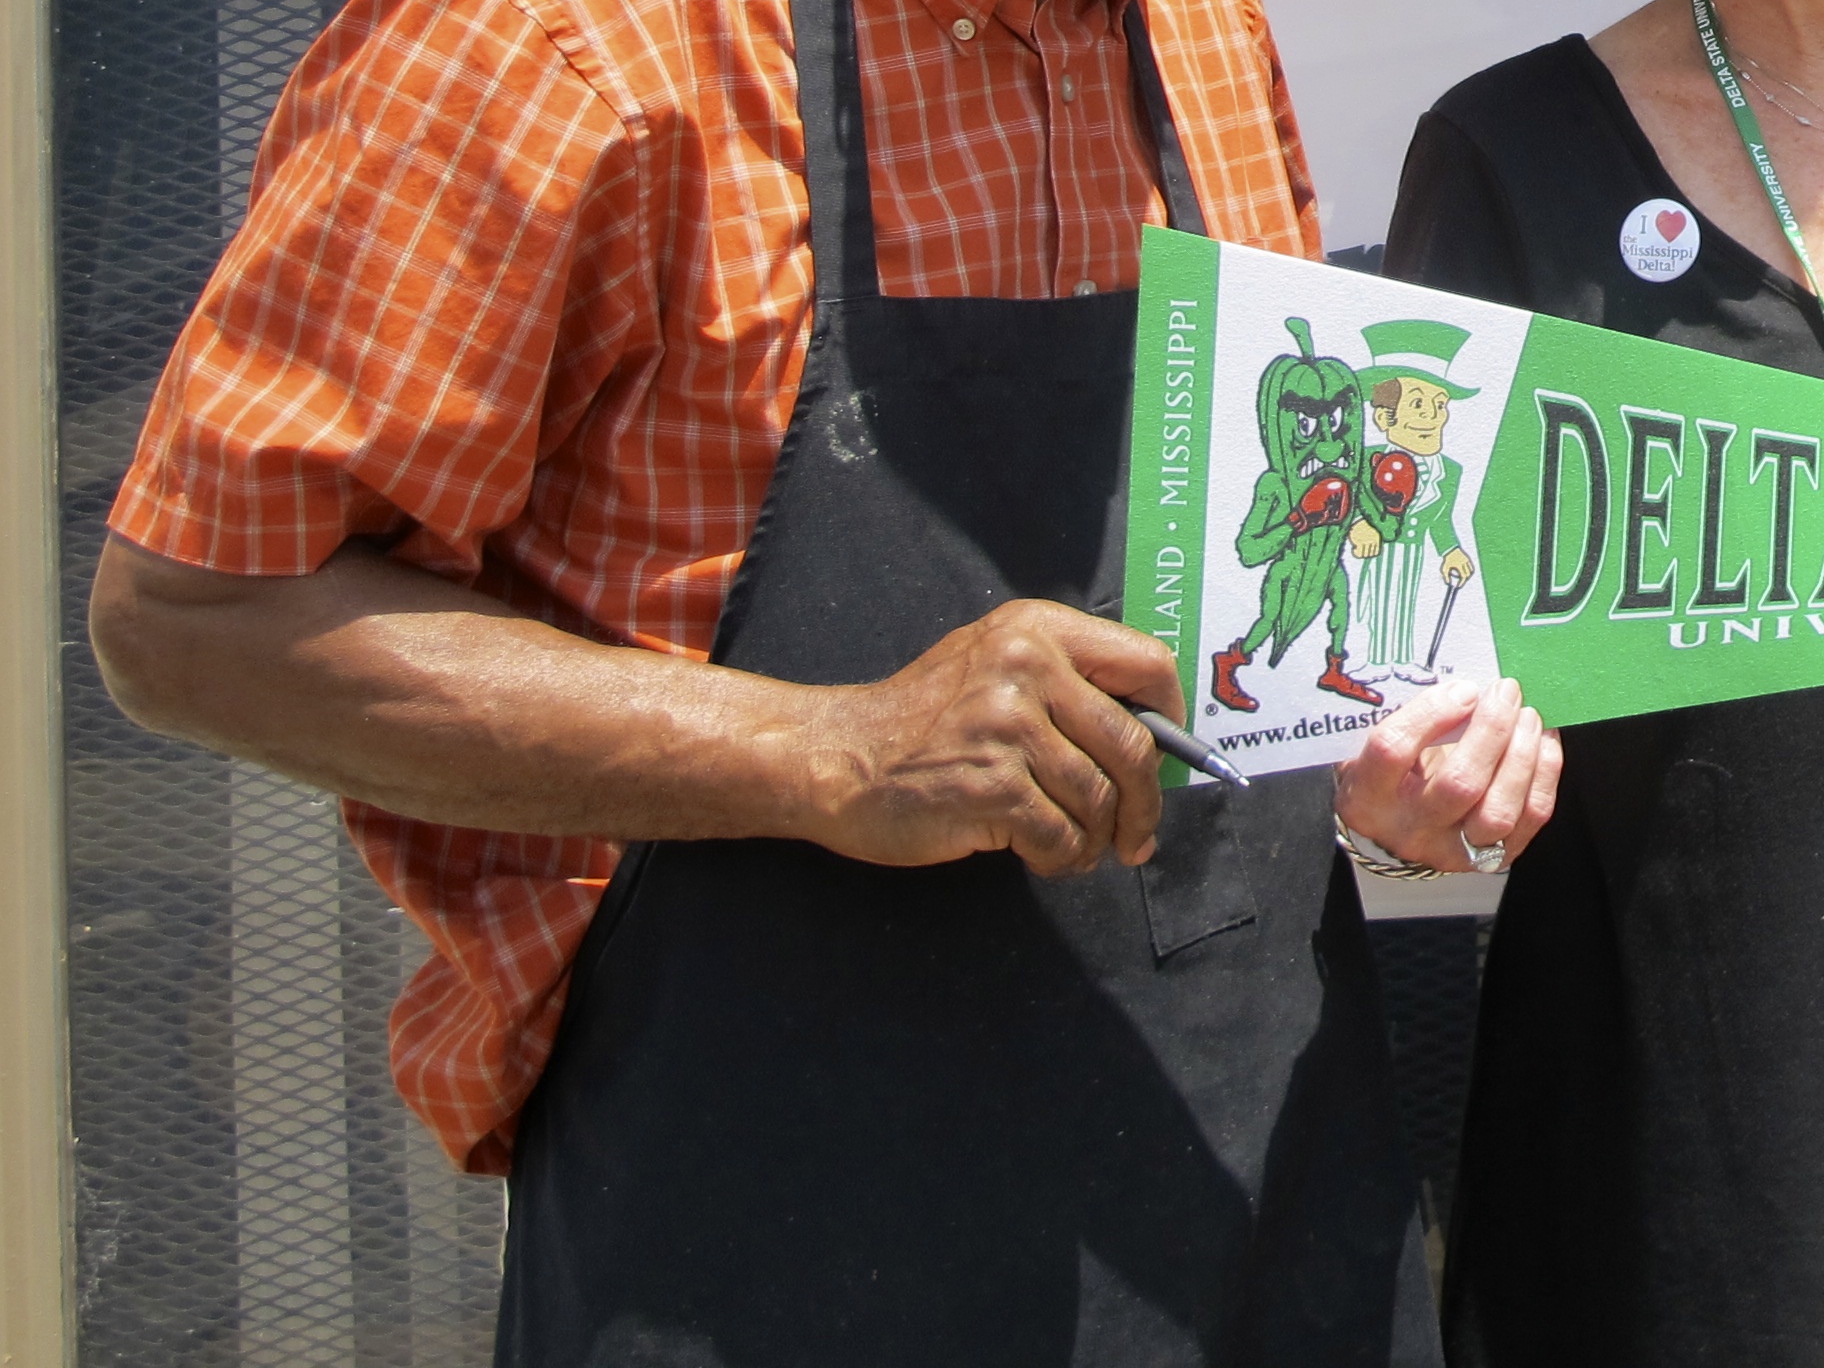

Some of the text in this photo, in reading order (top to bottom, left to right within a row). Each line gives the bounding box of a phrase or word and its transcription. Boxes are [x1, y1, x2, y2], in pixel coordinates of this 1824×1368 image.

[1700, 28, 1725, 67] STATE
[1717, 66, 1746, 108] DELTA
[1749, 142, 1800, 231] UNIVERSITY
[1623, 234, 1638, 243] the
[1639, 214, 1648, 234] I
[1622, 243, 1693, 261] Mississippi
[1637, 258, 1676, 272] Delta!
[1160, 299, 1198, 506] MISSISSIPPI
[1217, 704, 1402, 752] www.deltasta
